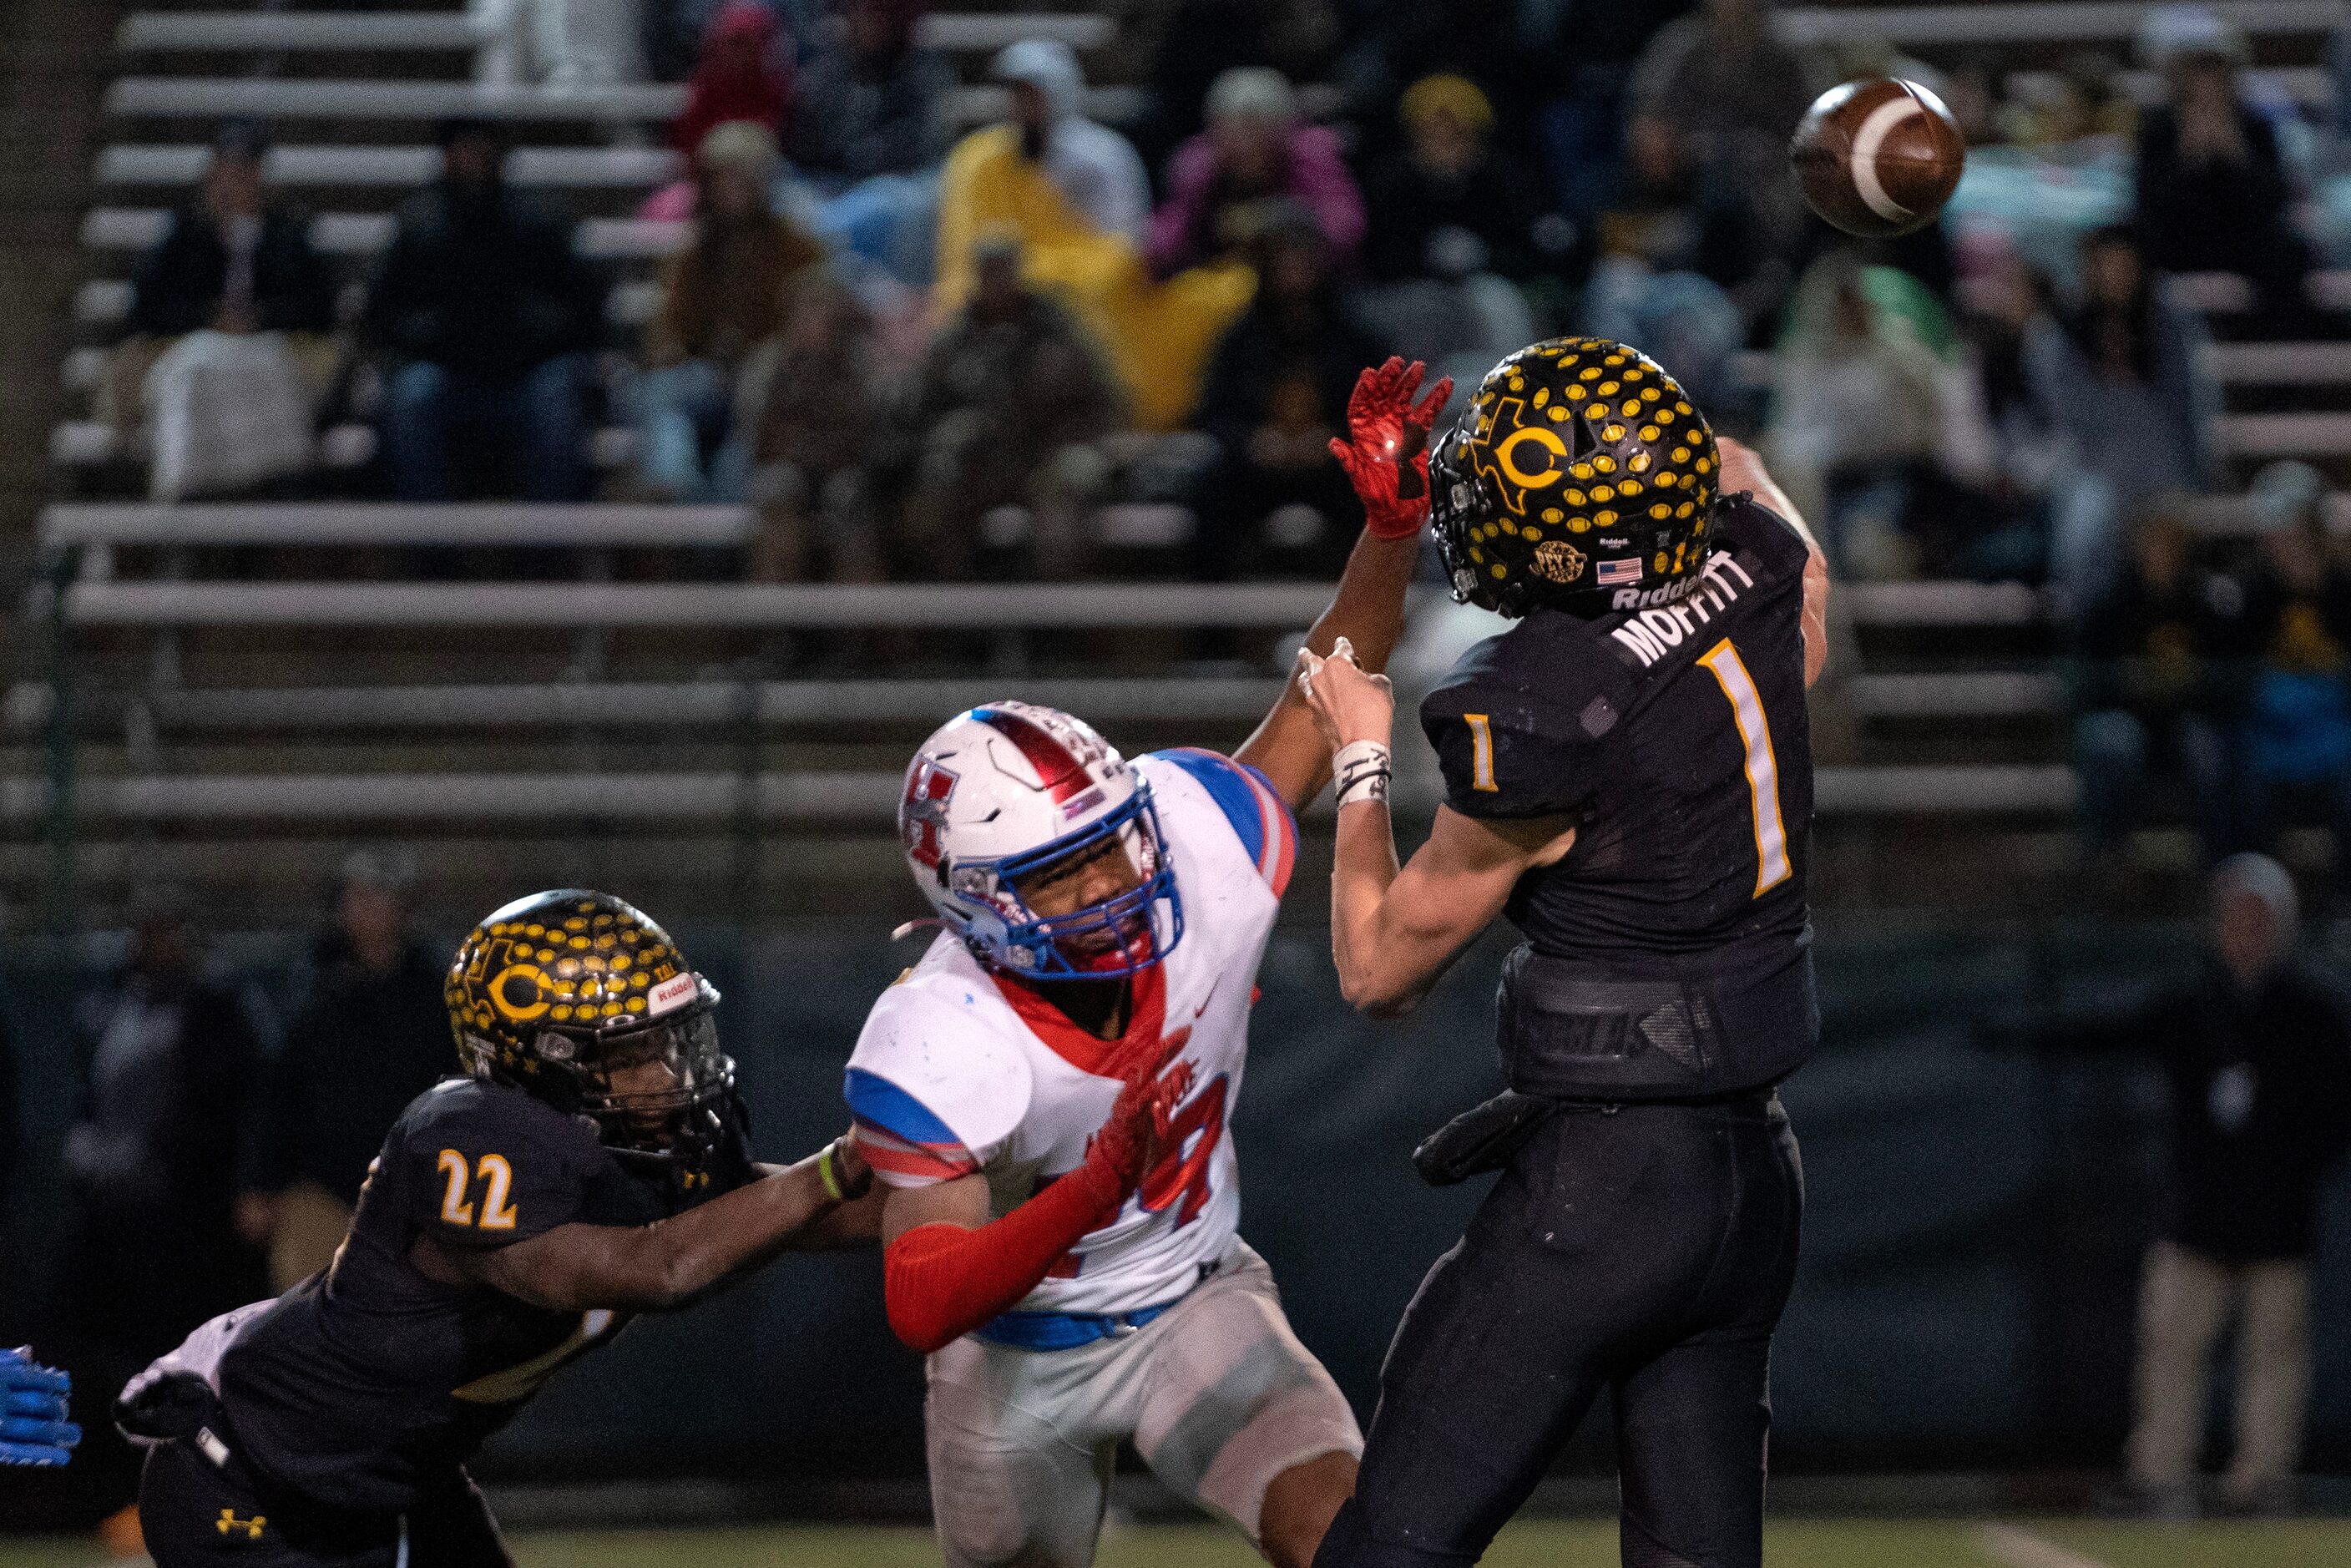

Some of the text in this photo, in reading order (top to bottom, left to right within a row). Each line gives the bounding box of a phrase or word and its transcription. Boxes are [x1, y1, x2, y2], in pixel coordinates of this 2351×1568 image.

[1610, 549, 1754, 668] MOFFITT
[1611, 574, 1701, 610] Ridde
[1464, 713, 1499, 793] 1
[1695, 636, 1793, 899] 1
[437, 1148, 518, 1230] 22
